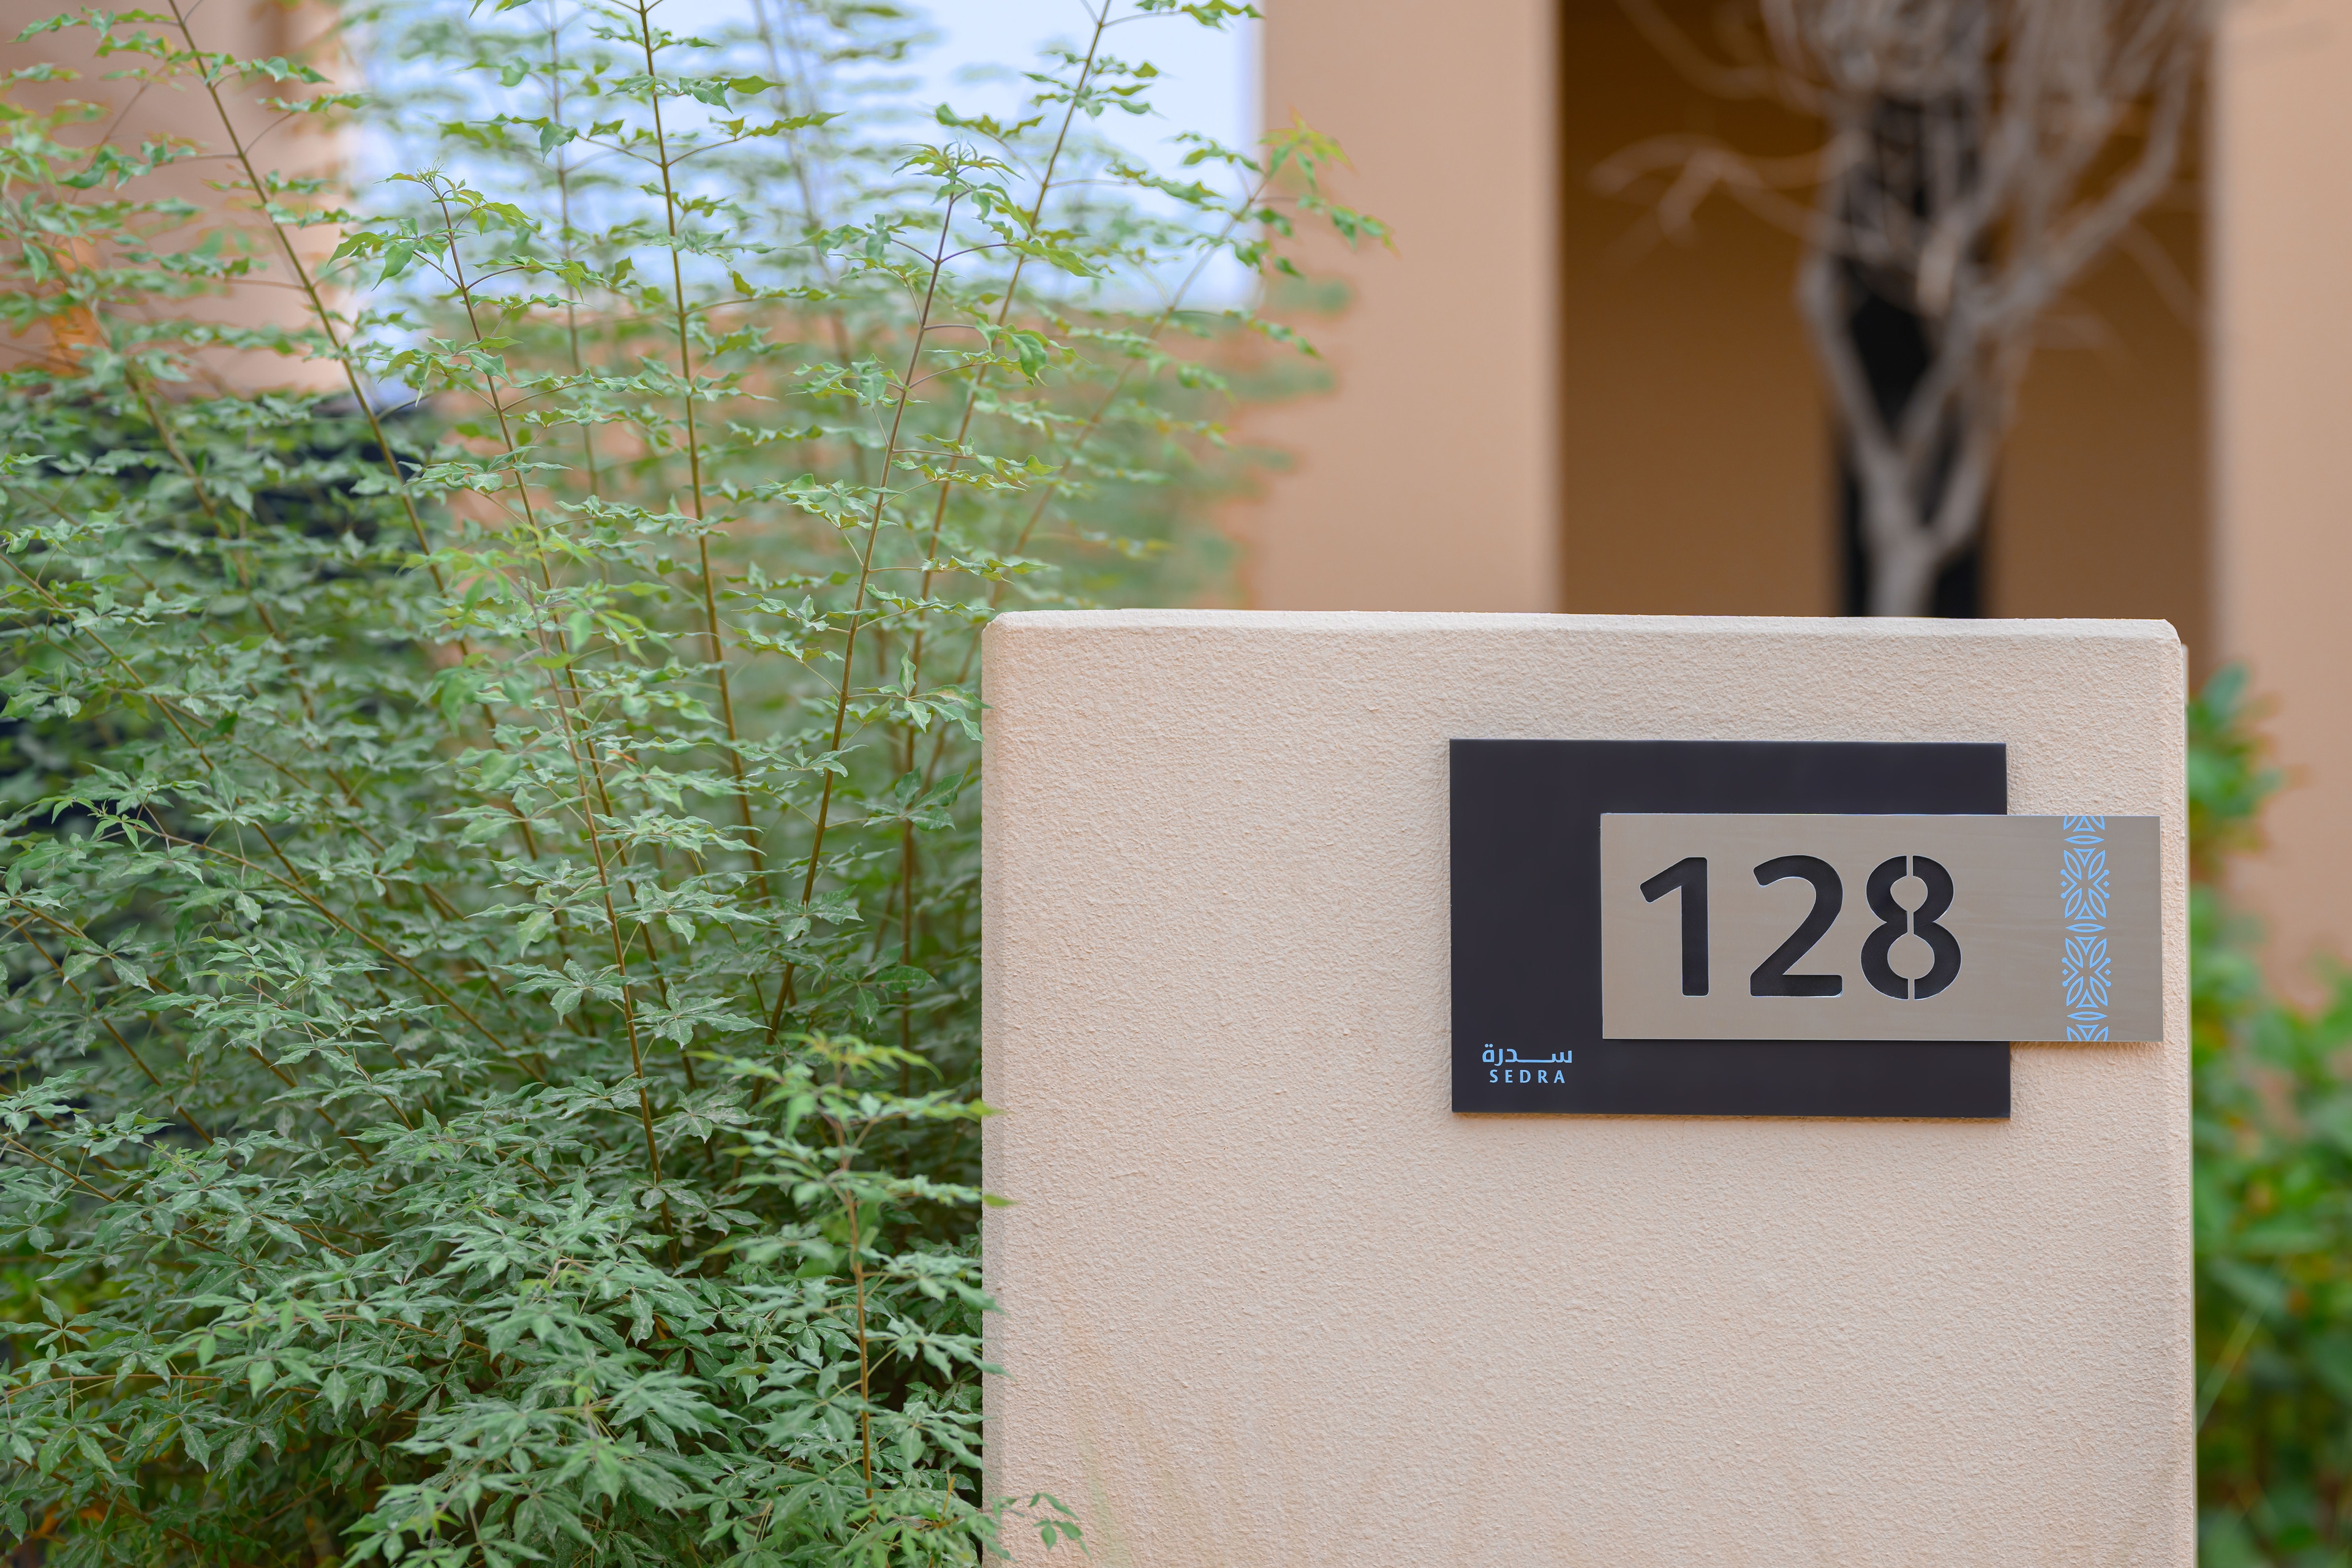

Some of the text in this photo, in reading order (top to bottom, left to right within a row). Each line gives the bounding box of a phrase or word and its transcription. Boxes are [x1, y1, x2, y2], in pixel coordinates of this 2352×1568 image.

[1639, 854, 1962, 1001] 128
[1482, 1043, 1572, 1066] سدرة
[1489, 1069, 1566, 1084] SEDRA
